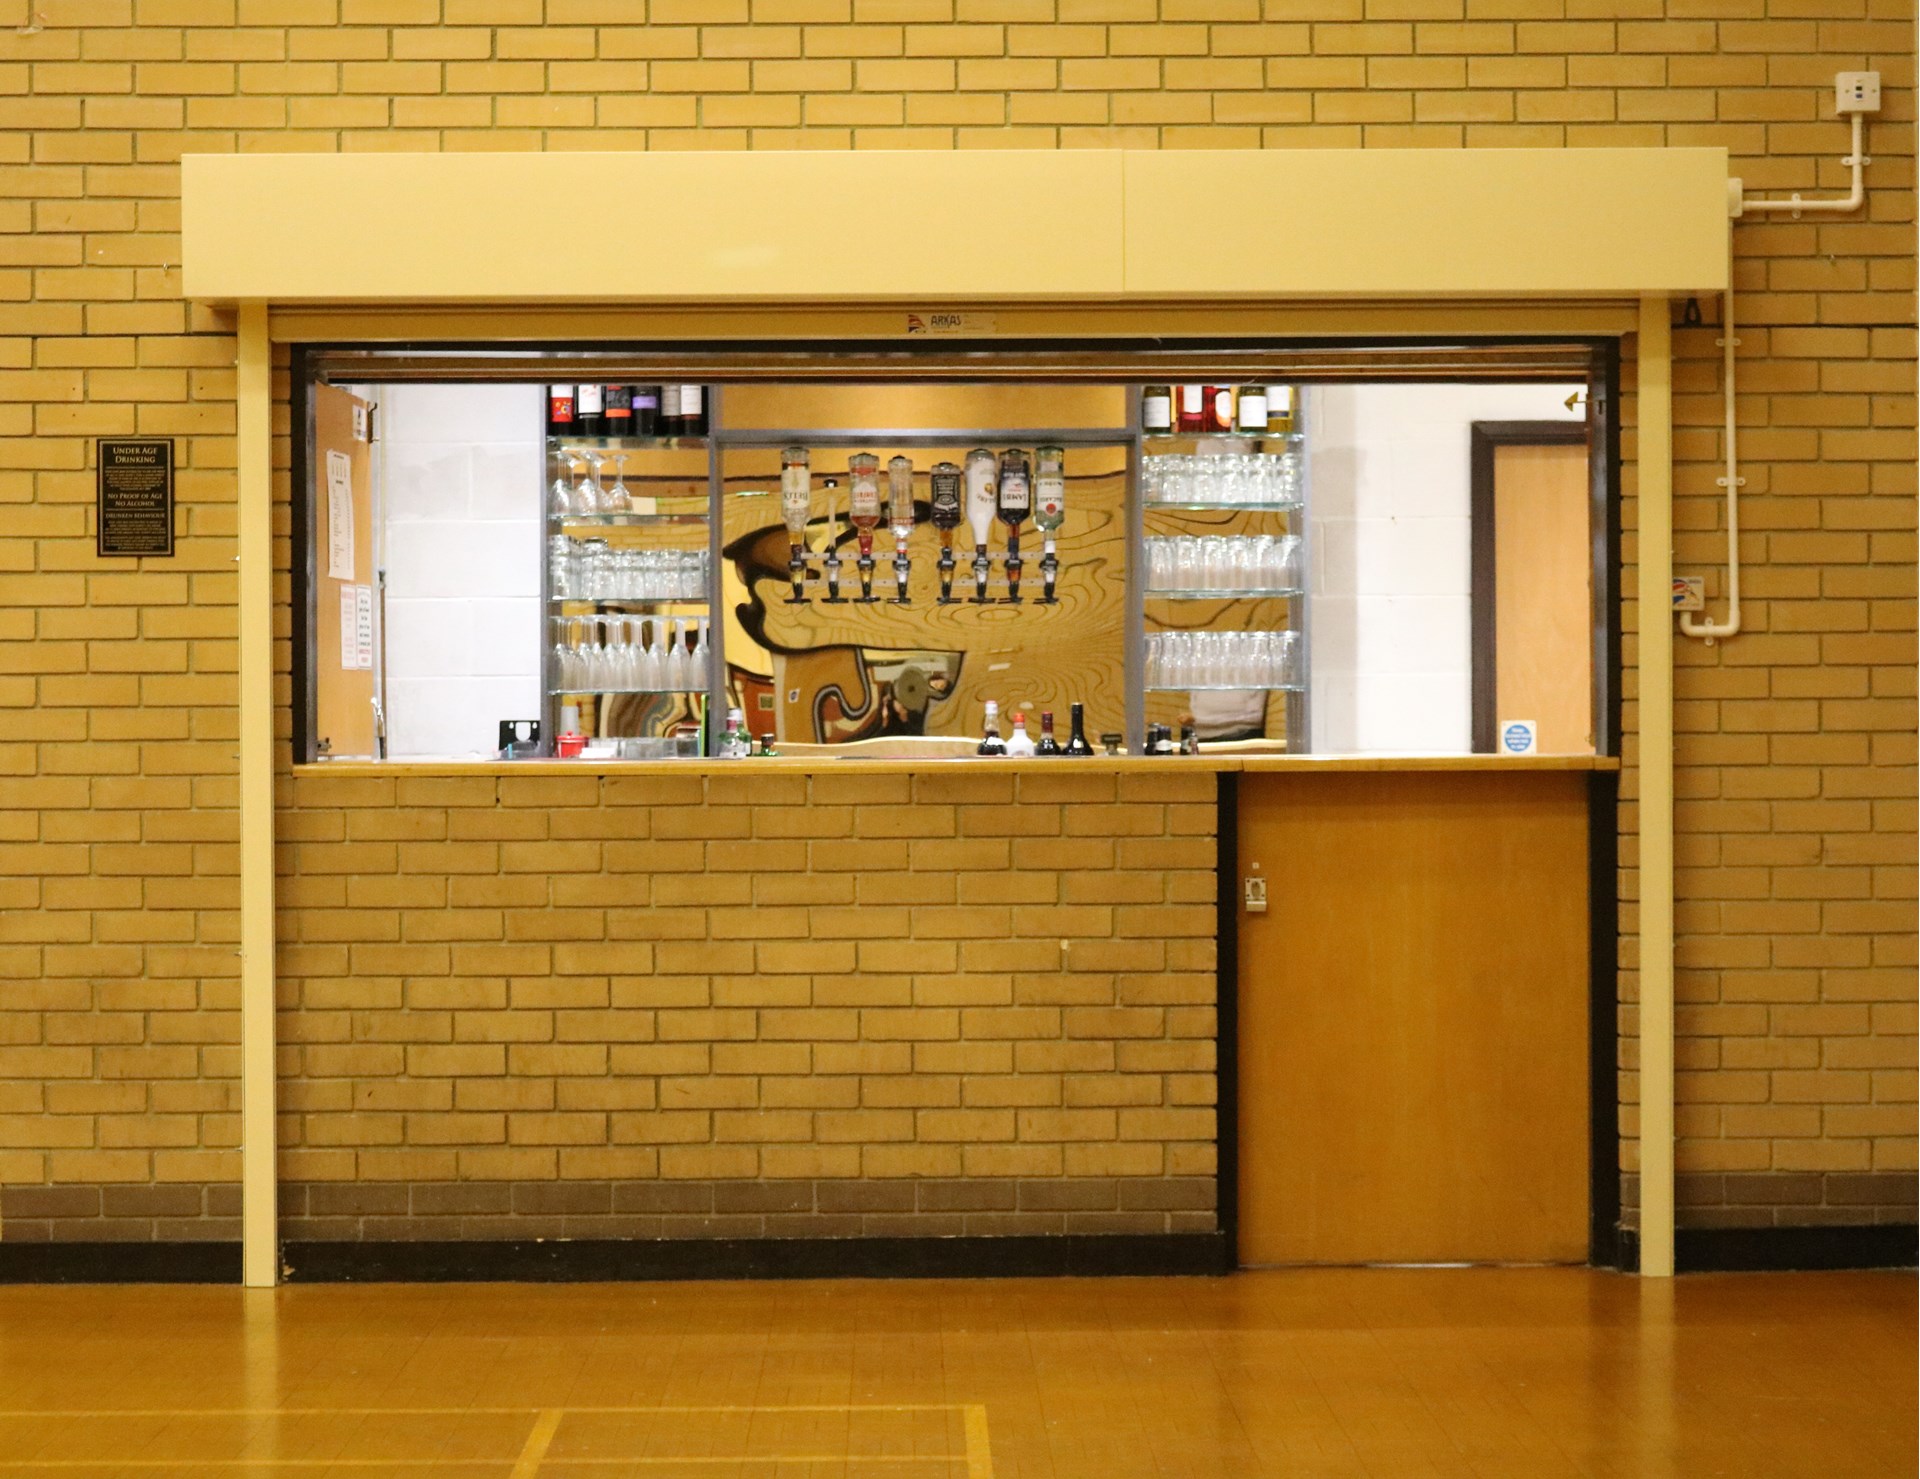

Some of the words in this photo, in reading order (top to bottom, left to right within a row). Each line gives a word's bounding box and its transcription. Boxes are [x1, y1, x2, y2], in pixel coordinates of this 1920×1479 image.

[931, 315, 961, 328] ARKAS
[113, 447, 140, 455] UNDER
[142, 447, 158, 455] AGE
